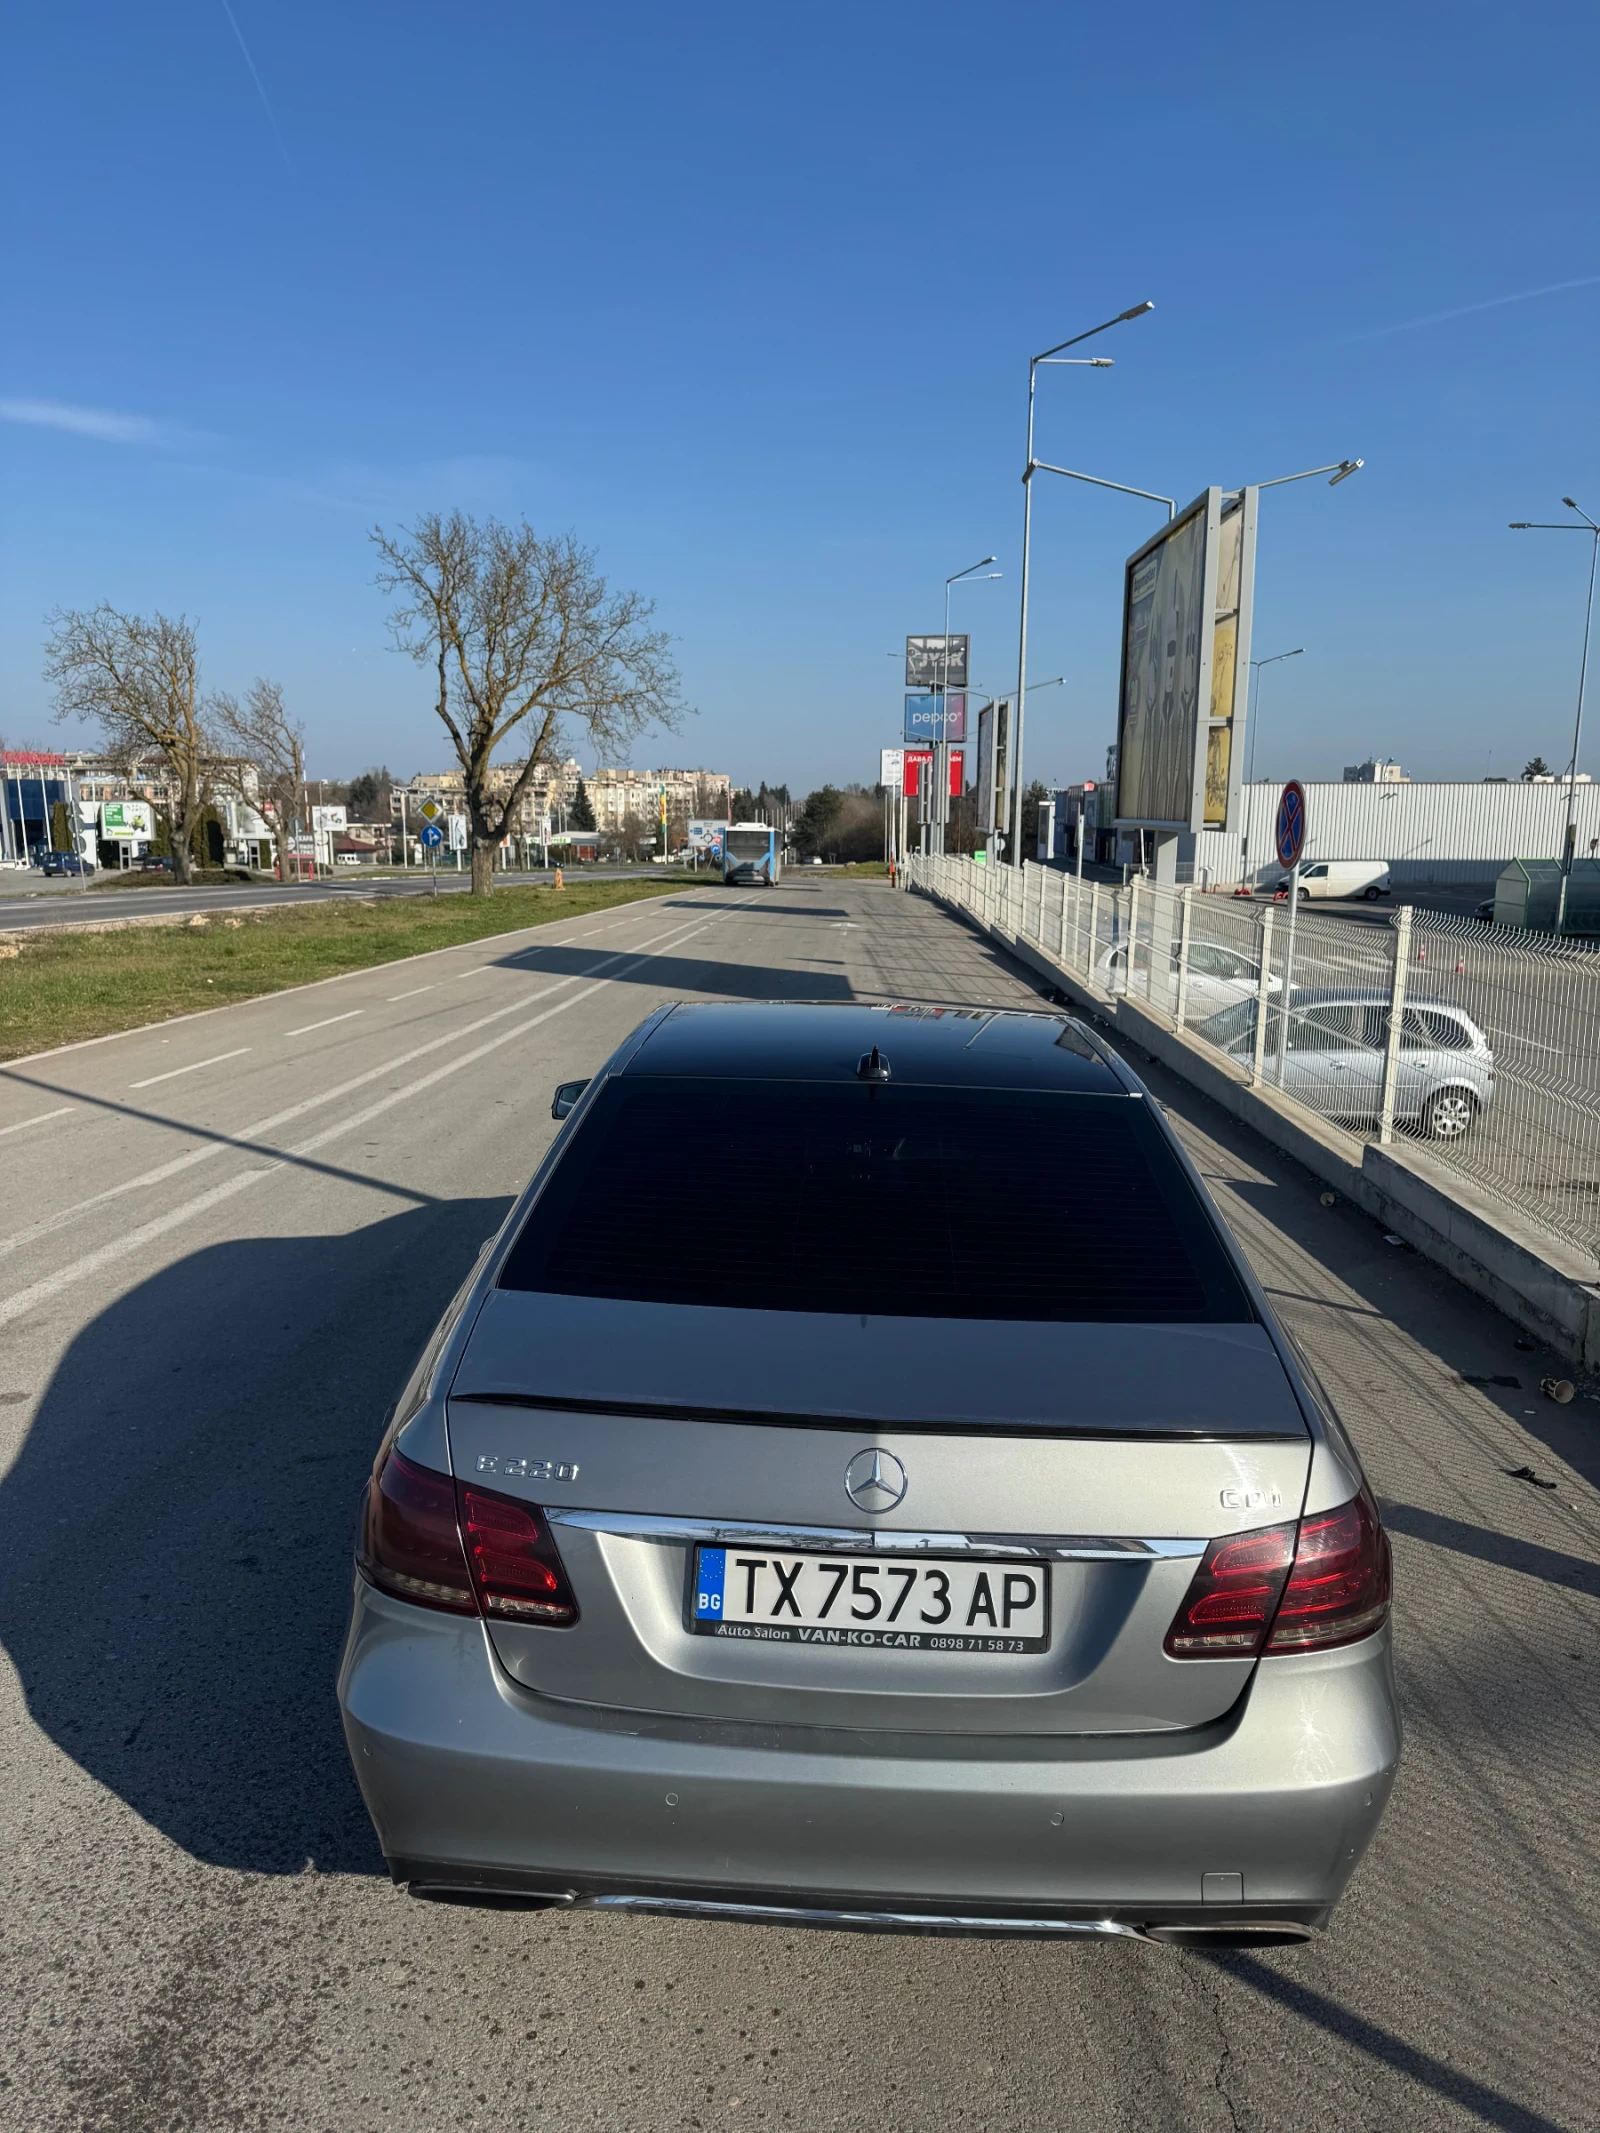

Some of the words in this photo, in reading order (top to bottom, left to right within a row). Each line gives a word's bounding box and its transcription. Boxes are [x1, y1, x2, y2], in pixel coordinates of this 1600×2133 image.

[920, 652, 964, 667] JYSK
[912, 712, 958, 724] pepco
[475, 1454, 499, 1473] E
[504, 1457, 579, 1482] 220
[698, 1592, 721, 1610] BG
[735, 1558, 804, 1618] TX
[817, 1563, 952, 1625] 7573
[965, 1571, 1037, 1629] AP
[716, 1624, 751, 1637] Auto
[754, 1626, 791, 1640] Salon
[797, 1628, 921, 1647] VAN-KO-CAR
[930, 1637, 964, 1649] 0898
[968, 1639, 983, 1650] 71
[988, 1640, 1004, 1651] 58
[1008, 1640, 1024, 1652] 73
